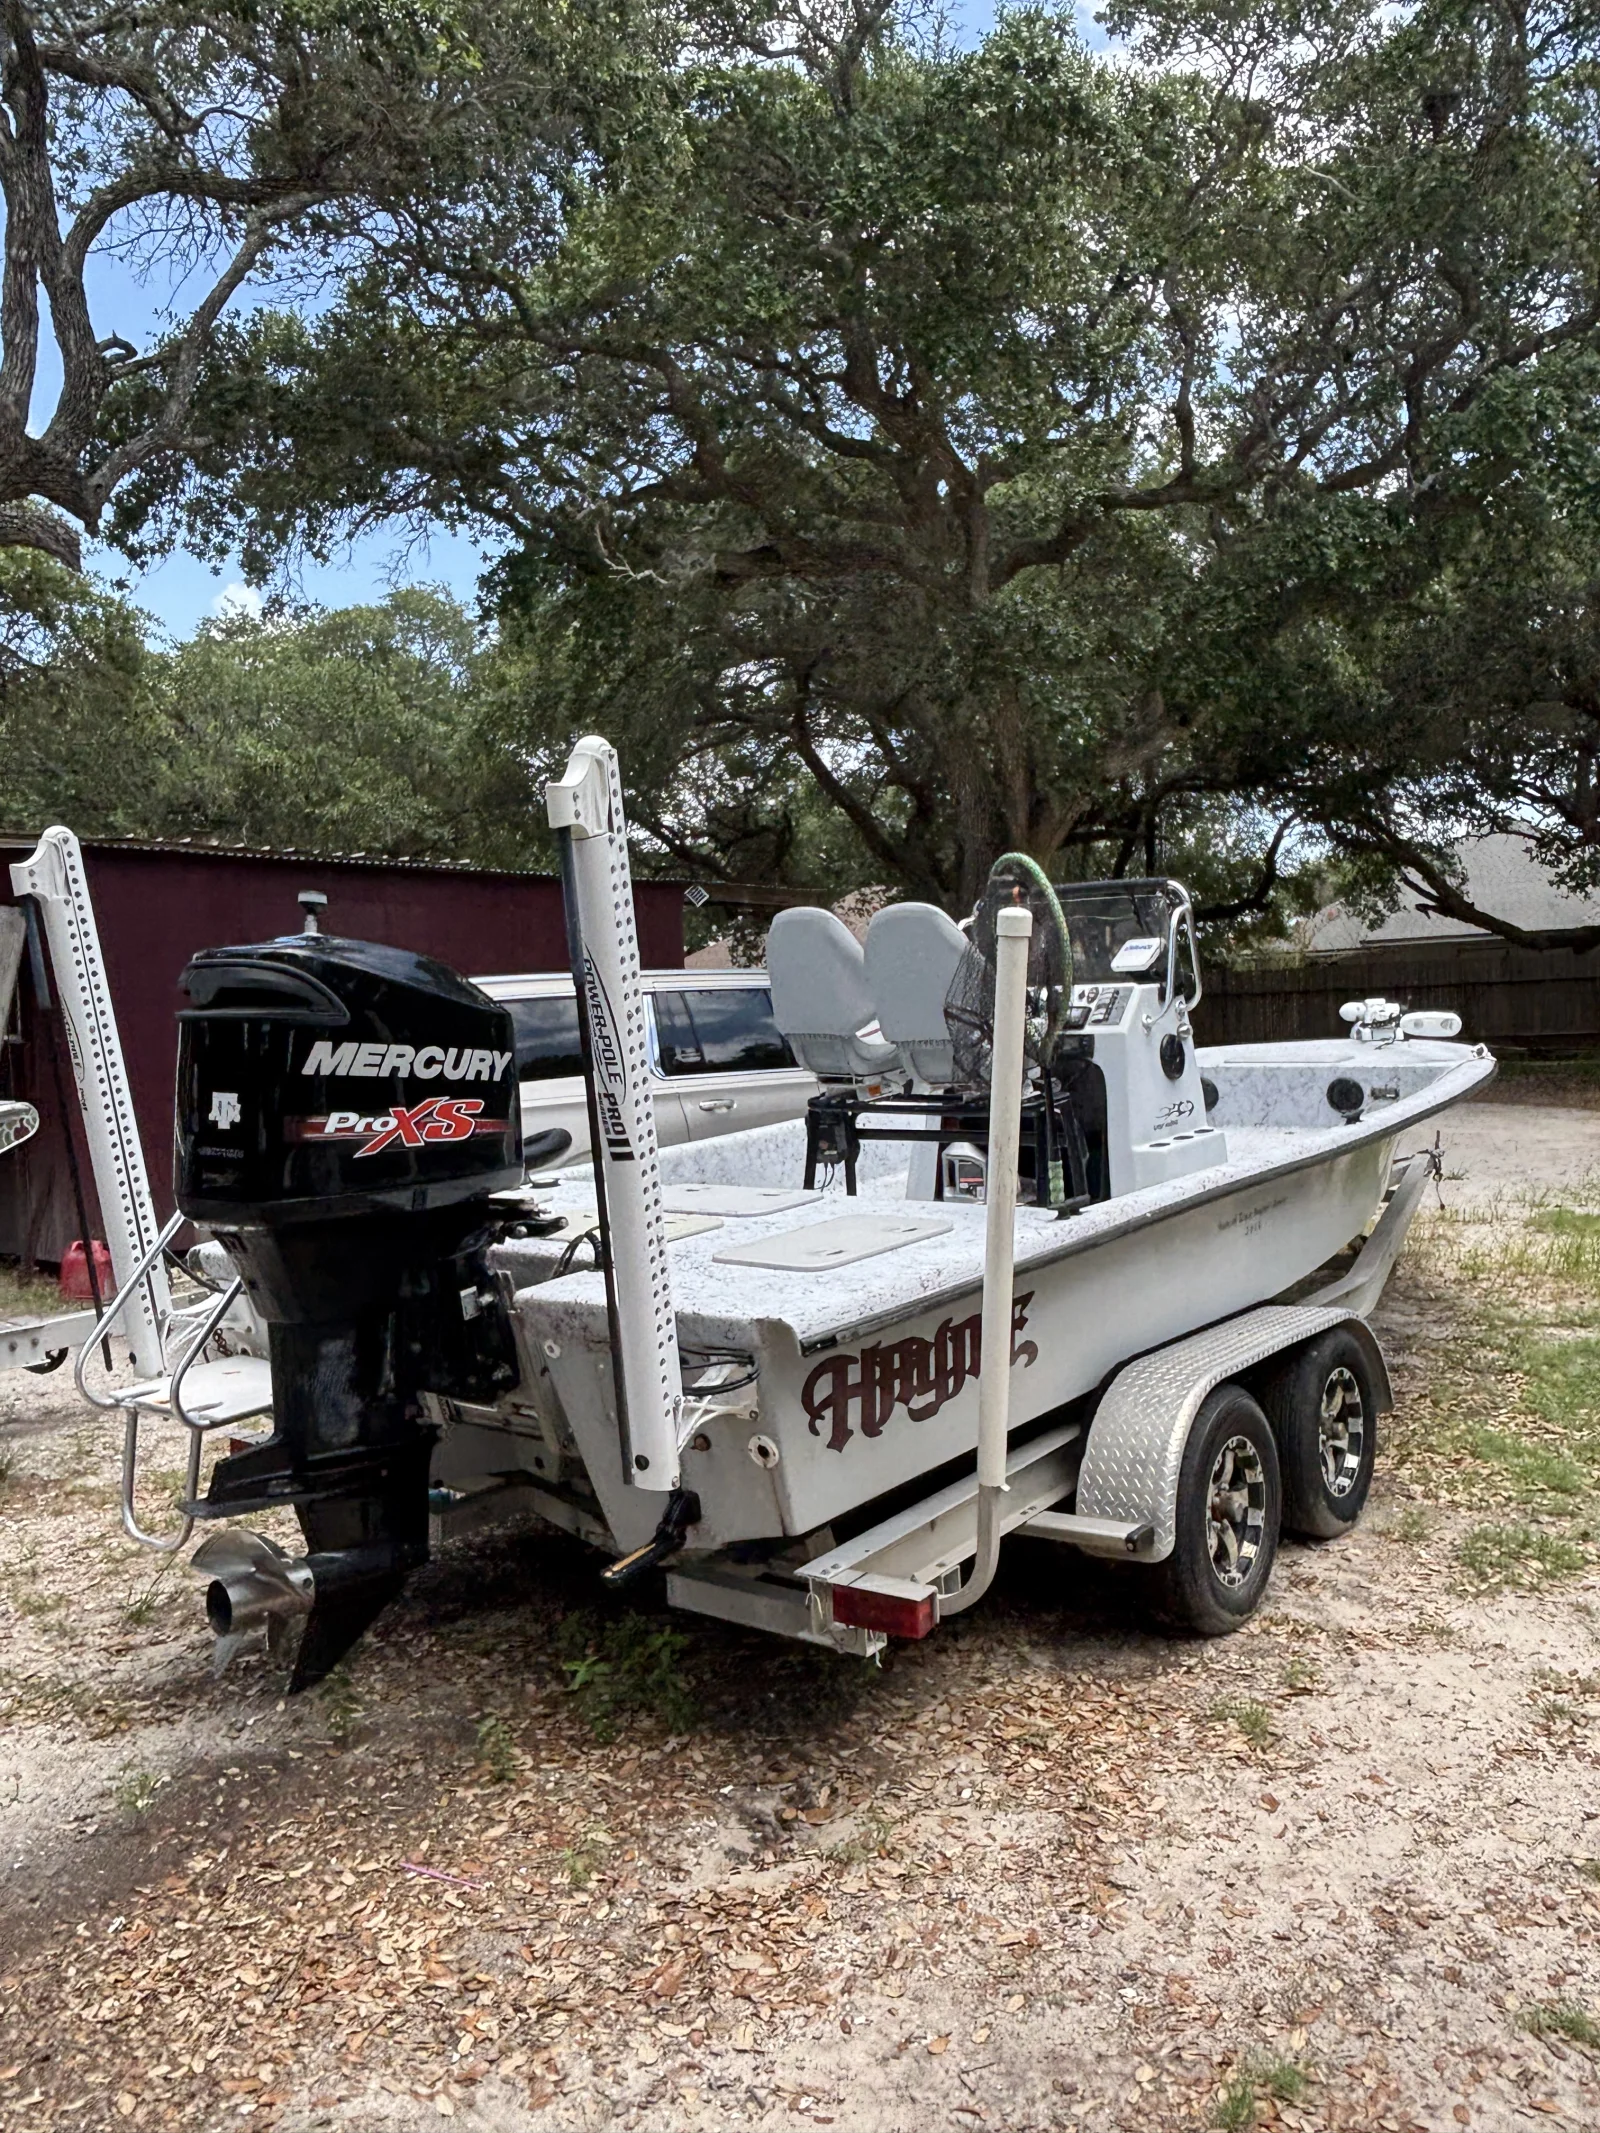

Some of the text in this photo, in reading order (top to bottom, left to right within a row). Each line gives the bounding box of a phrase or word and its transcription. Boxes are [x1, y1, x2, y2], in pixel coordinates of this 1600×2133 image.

[583, 958, 623, 1085] POWER-POLE
[301, 1040, 513, 1082] MERCURY
[603, 1092, 627, 1136] PRO
